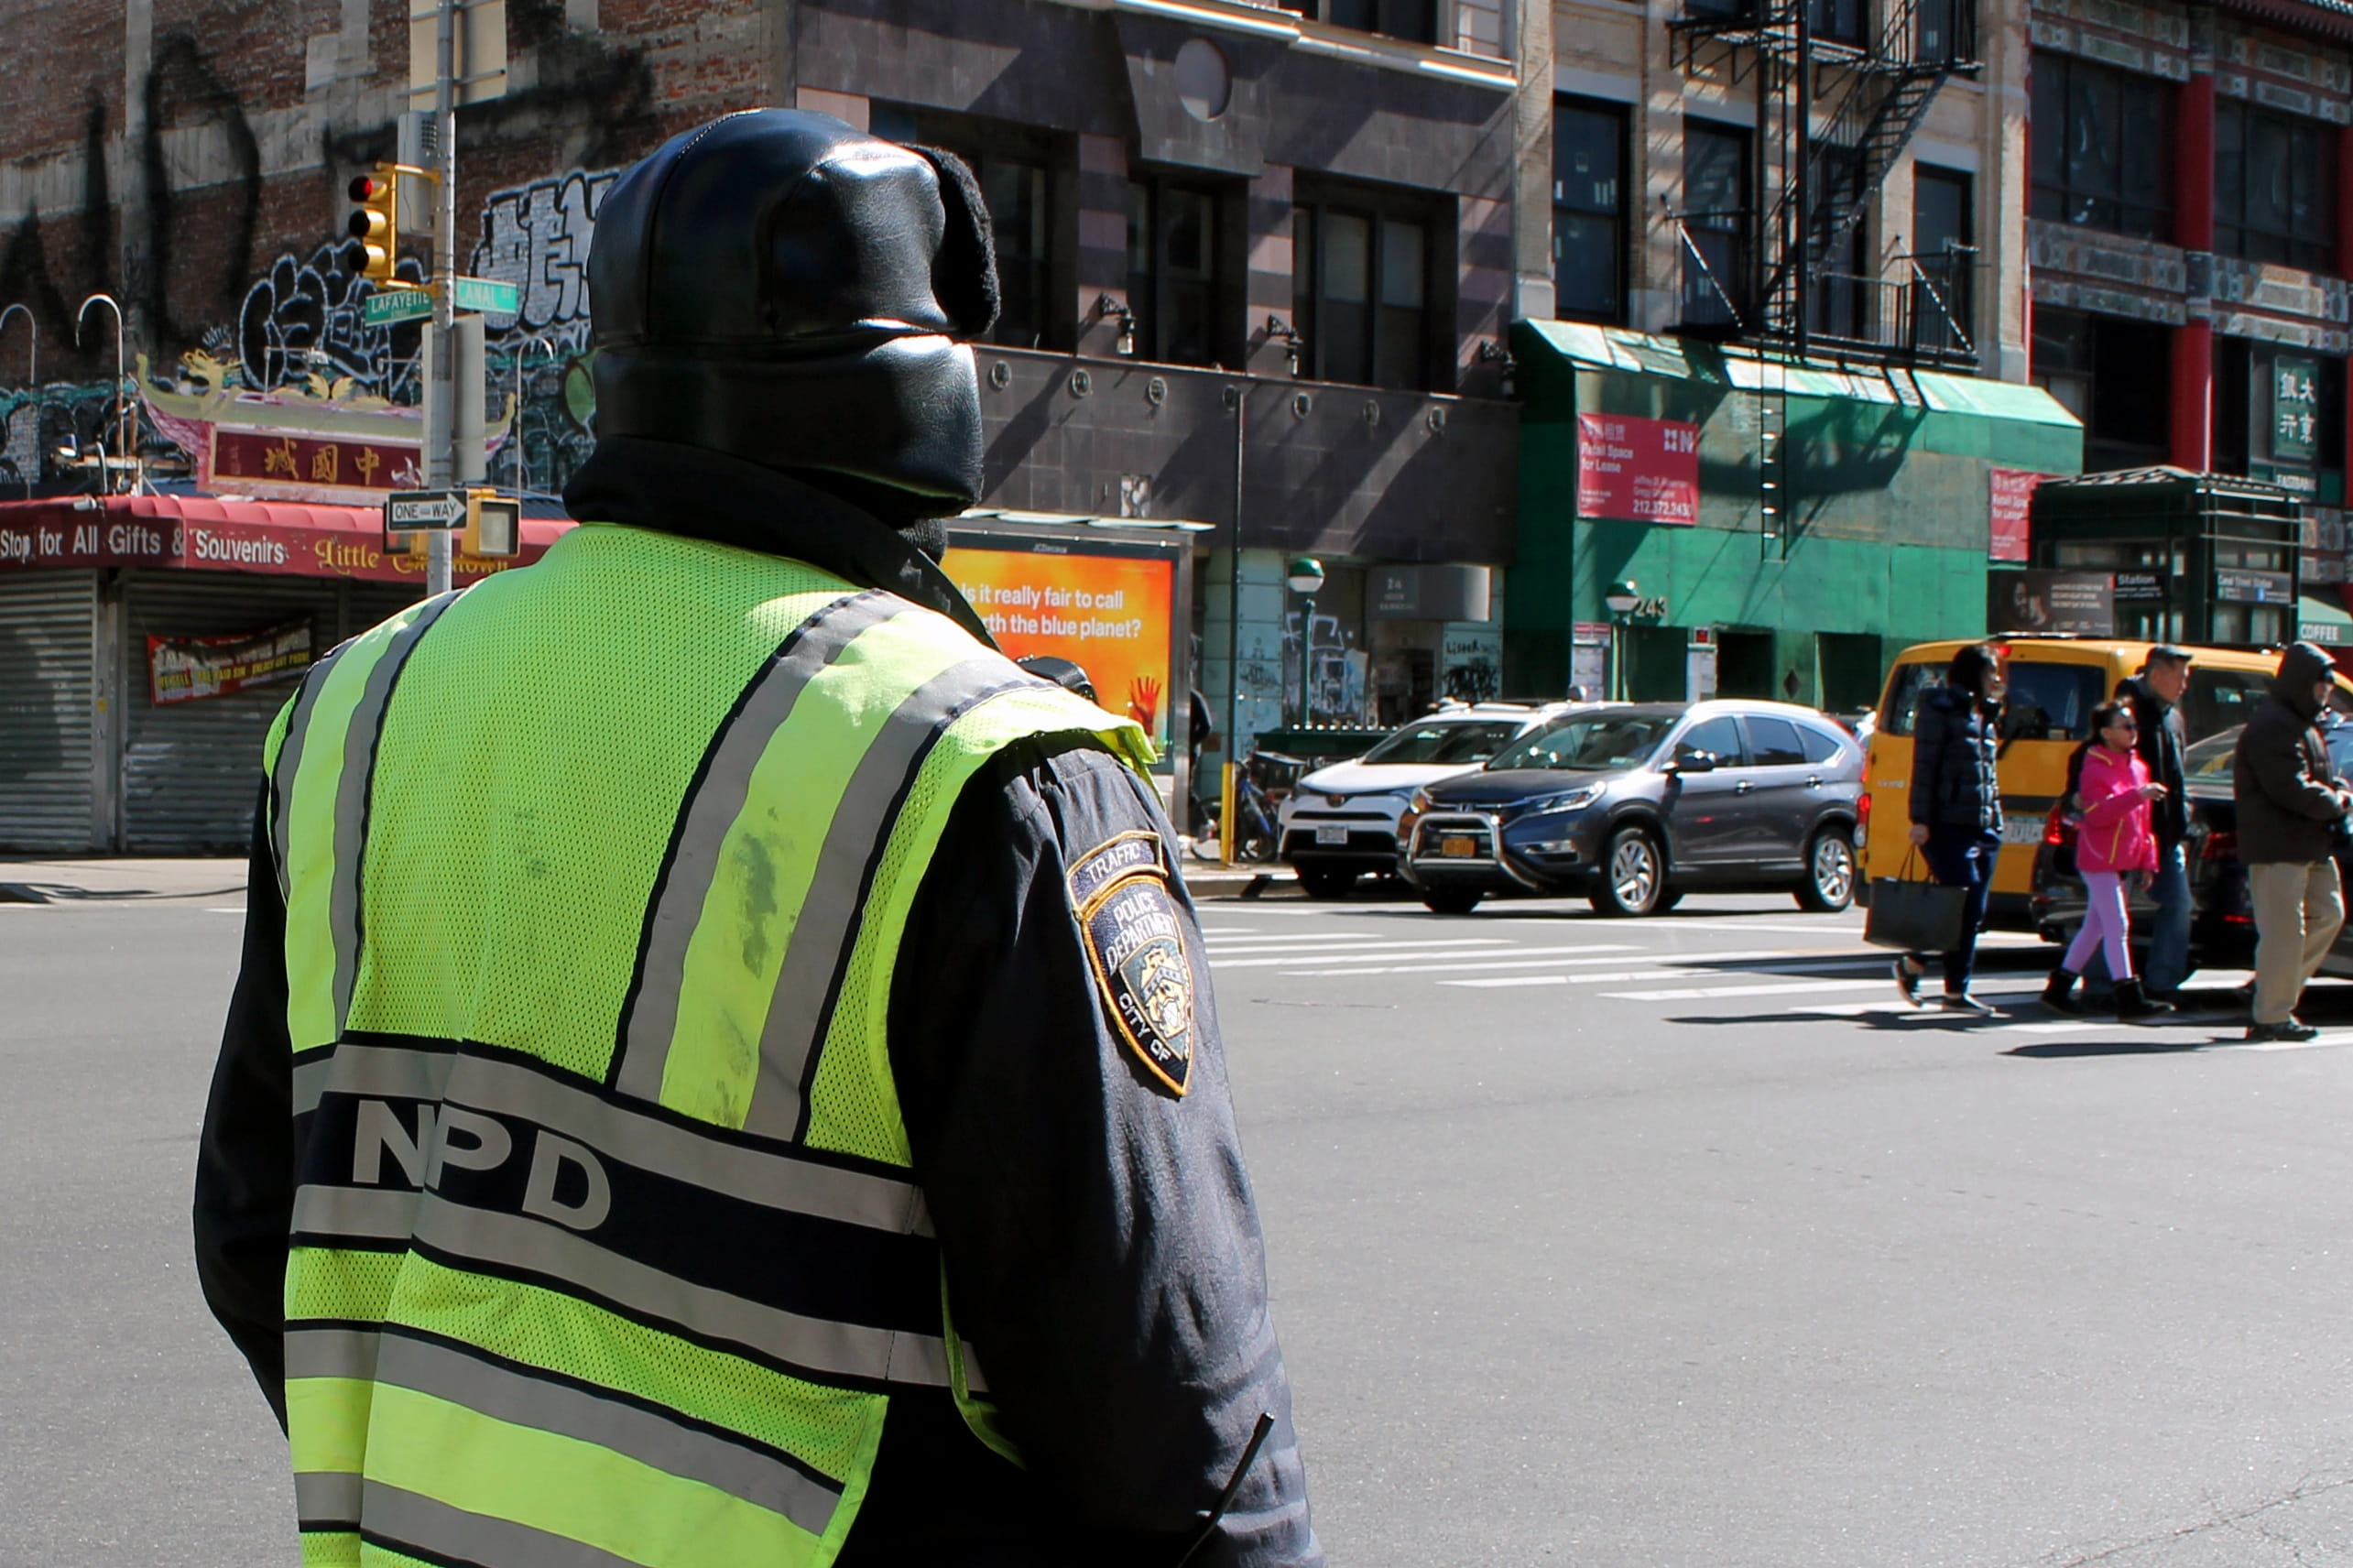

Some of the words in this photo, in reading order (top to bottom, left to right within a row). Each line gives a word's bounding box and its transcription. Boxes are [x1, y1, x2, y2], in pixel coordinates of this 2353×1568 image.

[371, 291, 430, 314] LAFAYETTE
[458, 280, 496, 308] CANAL
[1581, 441, 1606, 456] Retail
[1607, 444, 1633, 460] Space
[1581, 457, 1594, 470] for
[1596, 459, 1621, 473] Lease
[395, 505, 419, 519] ONE
[432, 503, 458, 518] WAY
[0, 528, 31, 563] Stop
[38, 527, 62, 556] for
[72, 525, 98, 554] All
[108, 525, 161, 554] Gifts
[171, 528, 184, 554] &
[195, 529, 285, 564] Souvenirs
[314, 537, 380, 576] Little
[2118, 574, 2156, 586] Station
[962, 583, 976, 603] Is
[980, 583, 992, 604] it
[994, 583, 1040, 611] really
[1043, 586, 1071, 606] fair
[1074, 588, 1093, 607] to
[1095, 590, 1124, 609] call
[1635, 597, 1667, 617] 243
[1010, 614, 1039, 635] the
[1041, 615, 1077, 637] blue
[1080, 618, 1142, 640] planet?
[2301, 624, 2338, 641] COFFEE
[1085, 841, 1141, 884] TRAFFIC
[1113, 891, 1159, 930] POLICE
[1118, 991, 1151, 1038] CITY
[1149, 1040, 1172, 1062] OF
